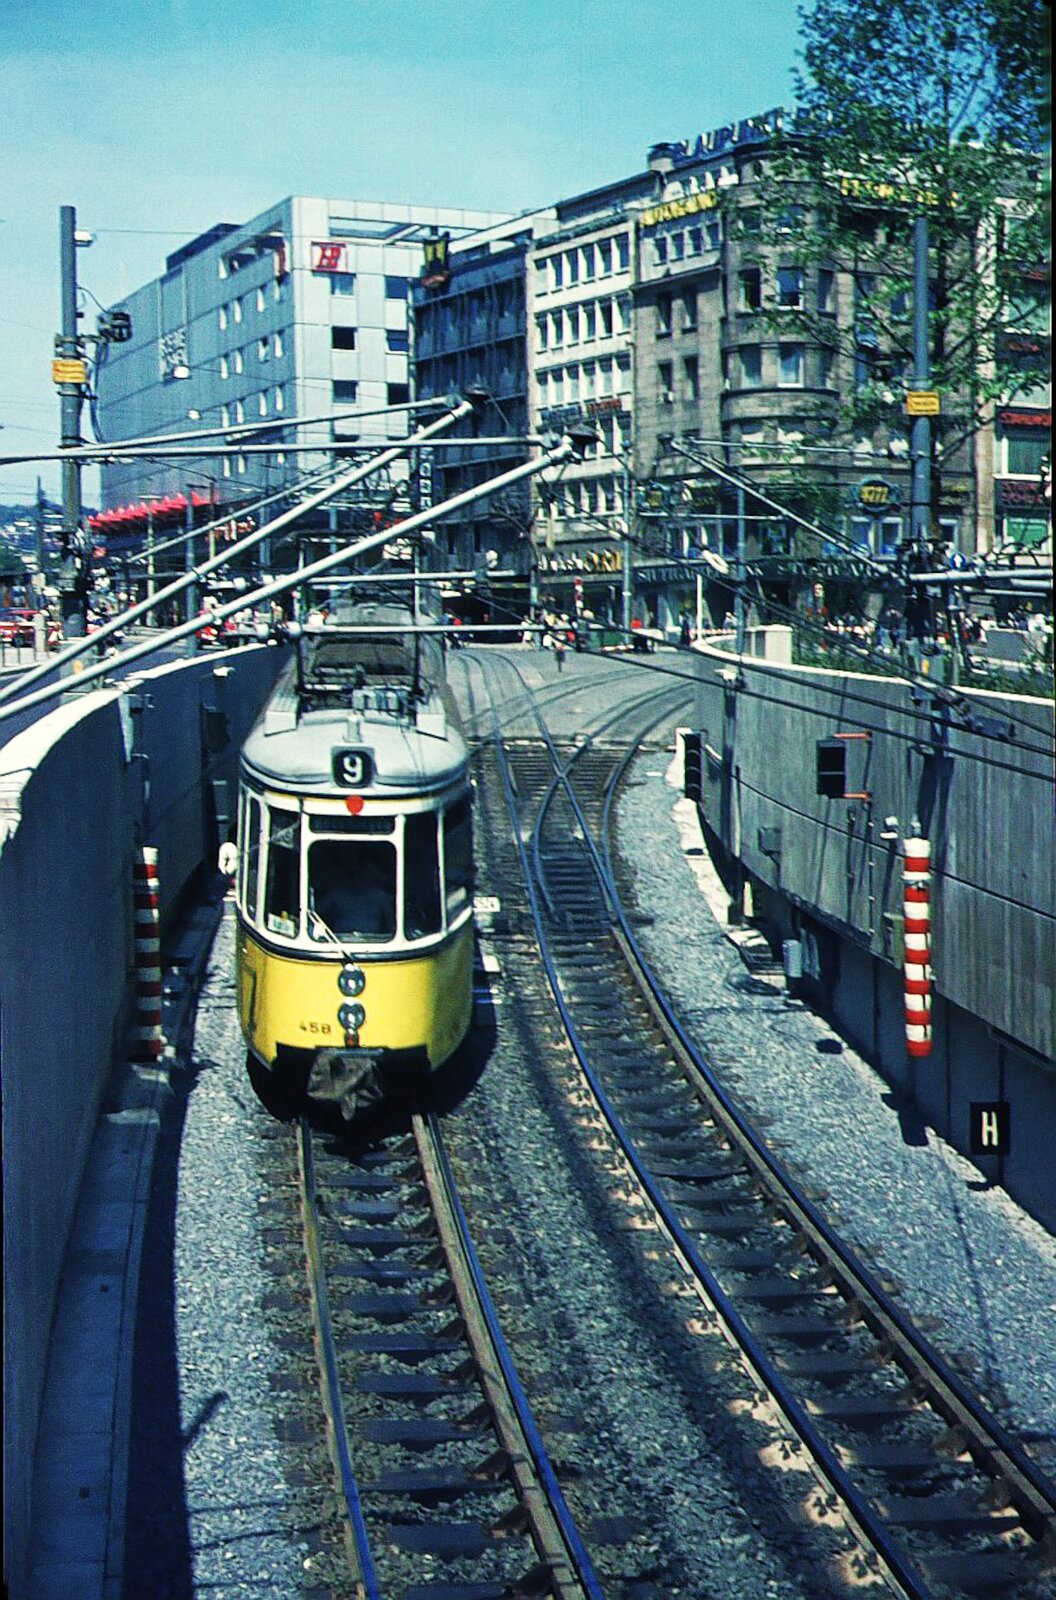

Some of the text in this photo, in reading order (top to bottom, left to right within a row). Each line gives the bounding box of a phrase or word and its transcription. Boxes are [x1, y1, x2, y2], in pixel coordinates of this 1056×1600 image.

[342, 755, 363, 783] 9
[299, 1021, 331, 1034] 458
[981, 1111, 999, 1147] H
